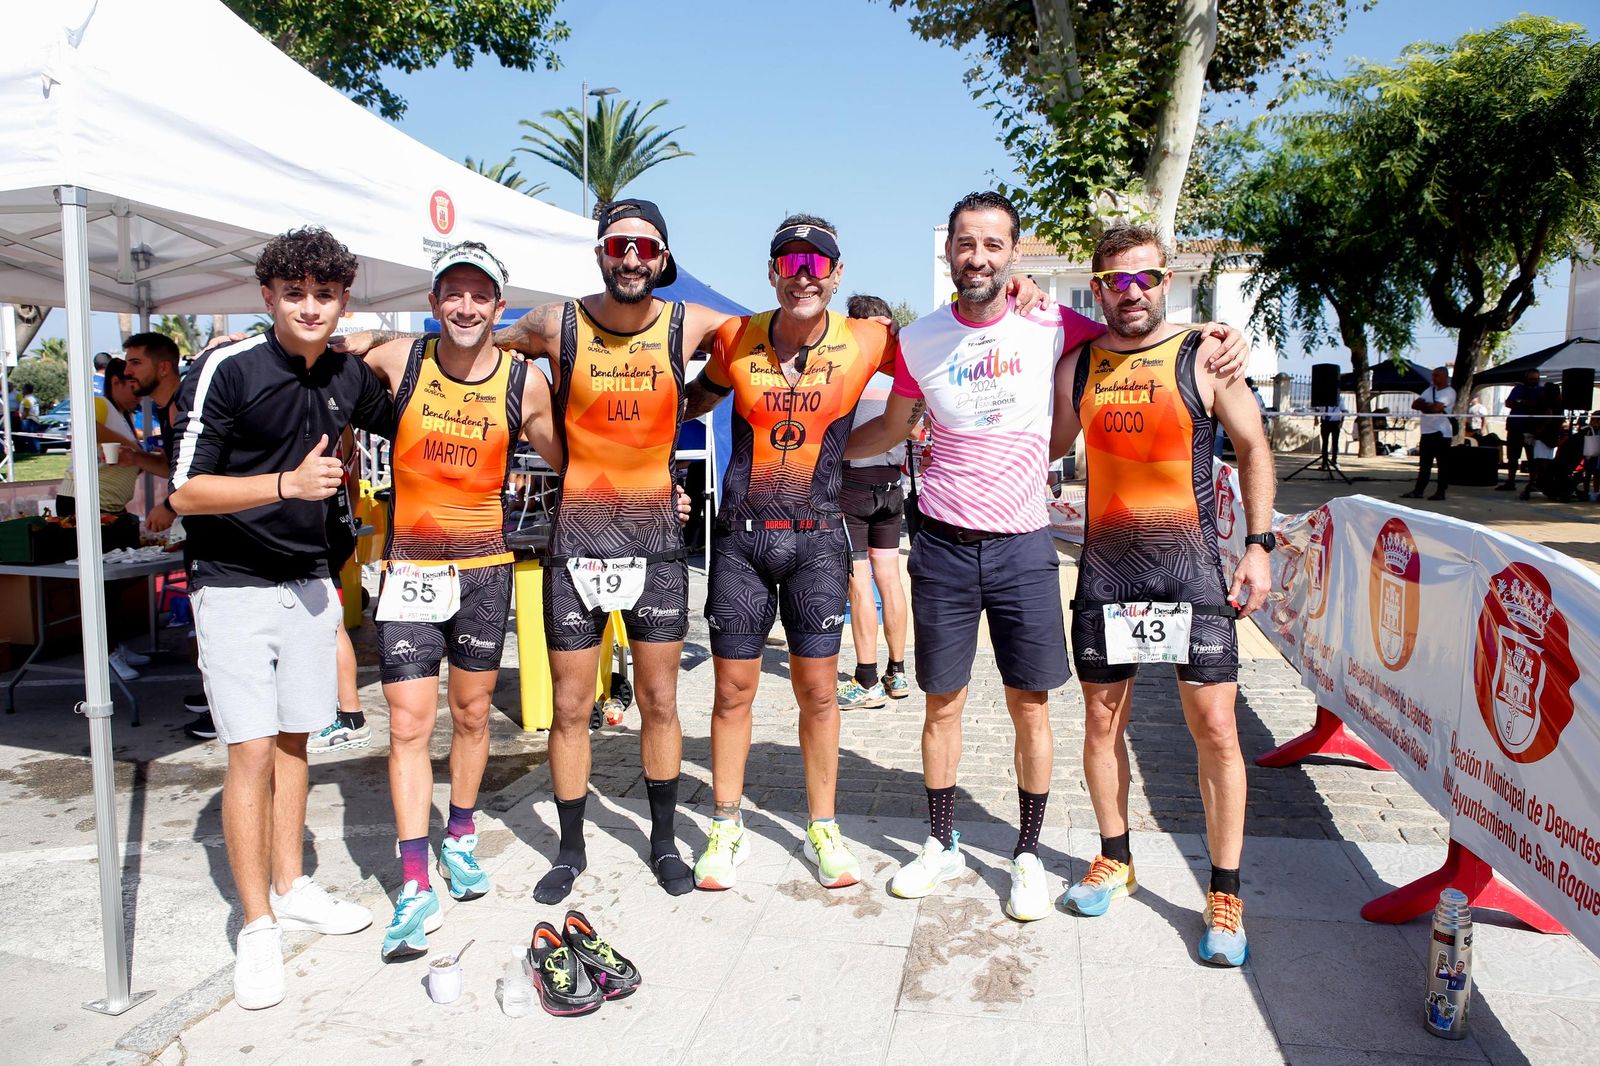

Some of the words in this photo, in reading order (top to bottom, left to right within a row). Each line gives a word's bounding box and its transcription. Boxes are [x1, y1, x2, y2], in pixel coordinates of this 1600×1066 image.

[591, 378, 653, 392] BRILLA
[971, 379, 997, 394] 2024
[763, 390, 821, 413] TXETXO
[992, 397, 1017, 406] ROQUE
[1095, 390, 1151, 406] BRILLA
[607, 399, 640, 421] LALA
[421, 417, 484, 441] BRILLA
[1104, 411, 1144, 433] COCO
[423, 438, 478, 468] MARITO
[402, 580, 437, 603] 55
[590, 574, 622, 594] 19
[1132, 620, 1166, 643] 43
[1406, 697, 1433, 735] Deportes
[1410, 736, 1429, 771] Roque
[1483, 759, 1526, 815] Municipal
[1527, 794, 1543, 826] de
[1544, 803, 1600, 866] Deportes
[1451, 783, 1517, 853] Ayuntamiento
[1519, 833, 1532, 865] de
[1535, 843, 1555, 884] San
[1557, 860, 1600, 917] Roque
